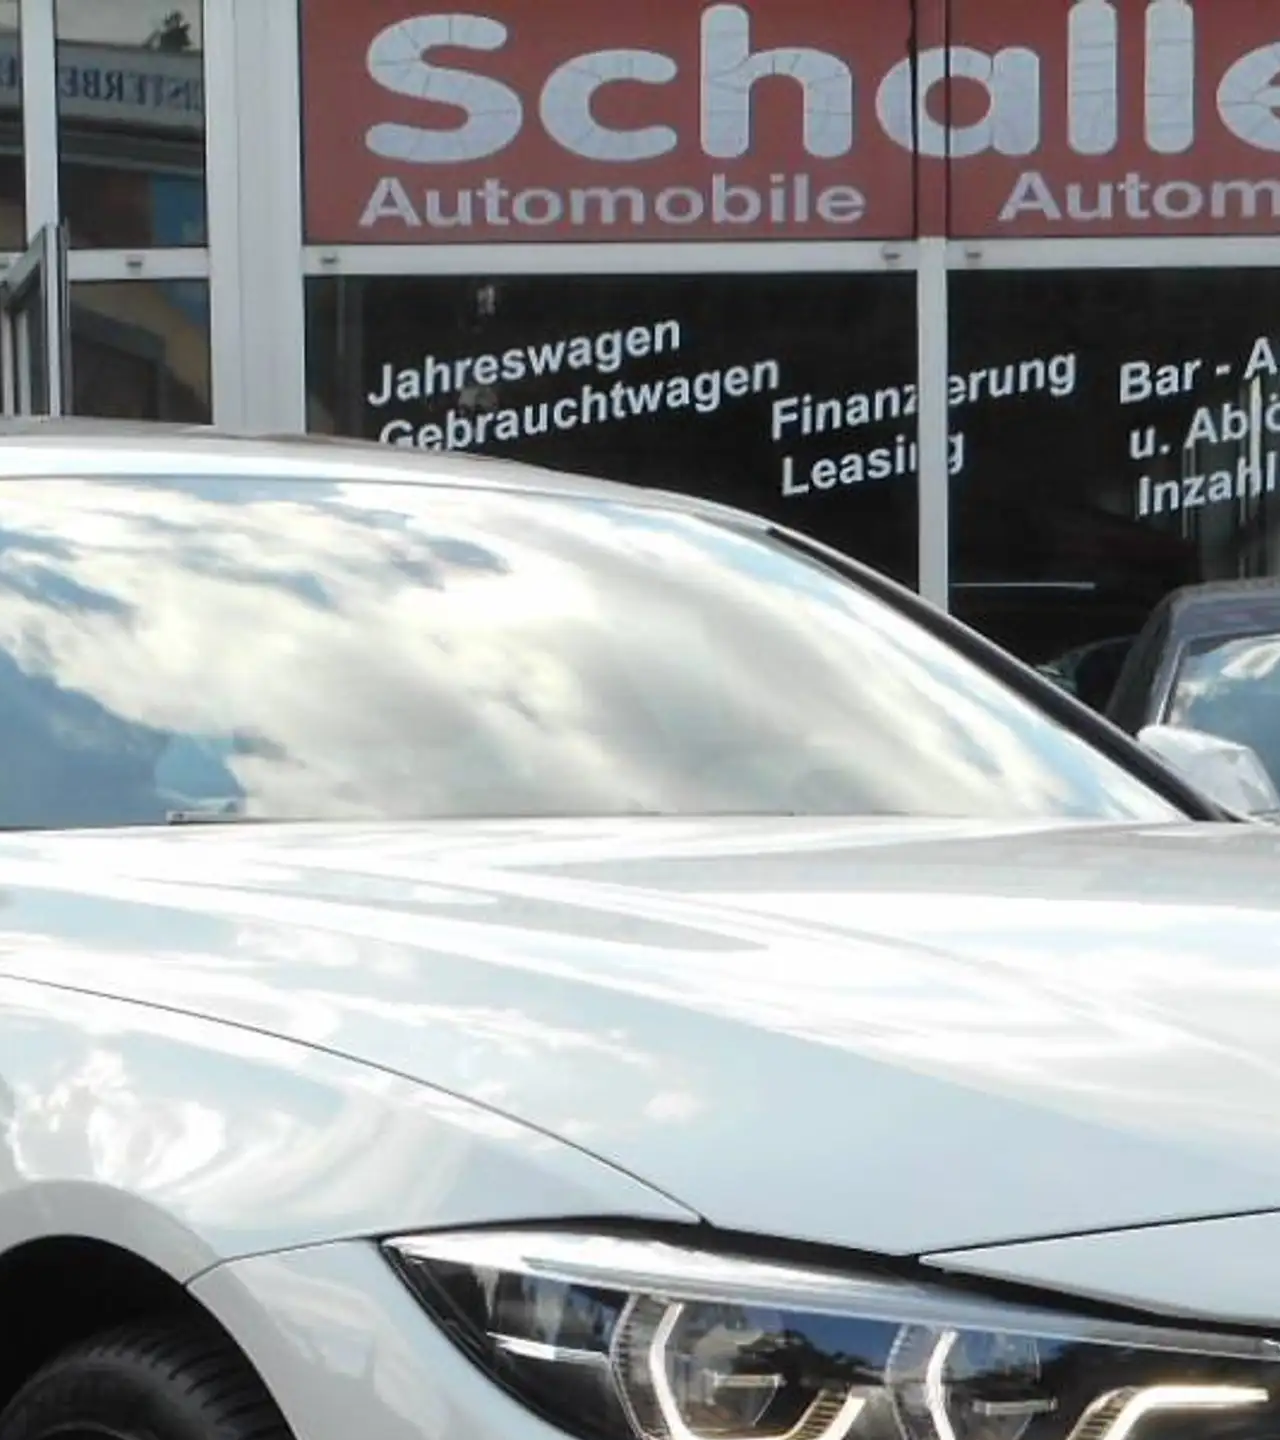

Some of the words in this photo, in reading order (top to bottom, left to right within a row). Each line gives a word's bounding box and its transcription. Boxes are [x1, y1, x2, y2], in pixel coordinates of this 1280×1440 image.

[358, 173, 867, 228] Automobile
[367, 318, 681, 405] Jahreswagen
[772, 352, 1076, 441] Finanzerung
[1120, 357, 1203, 404] Bar
[379, 359, 780, 452] Gebrauchtwagen
[1129, 425, 1170, 460] u.
